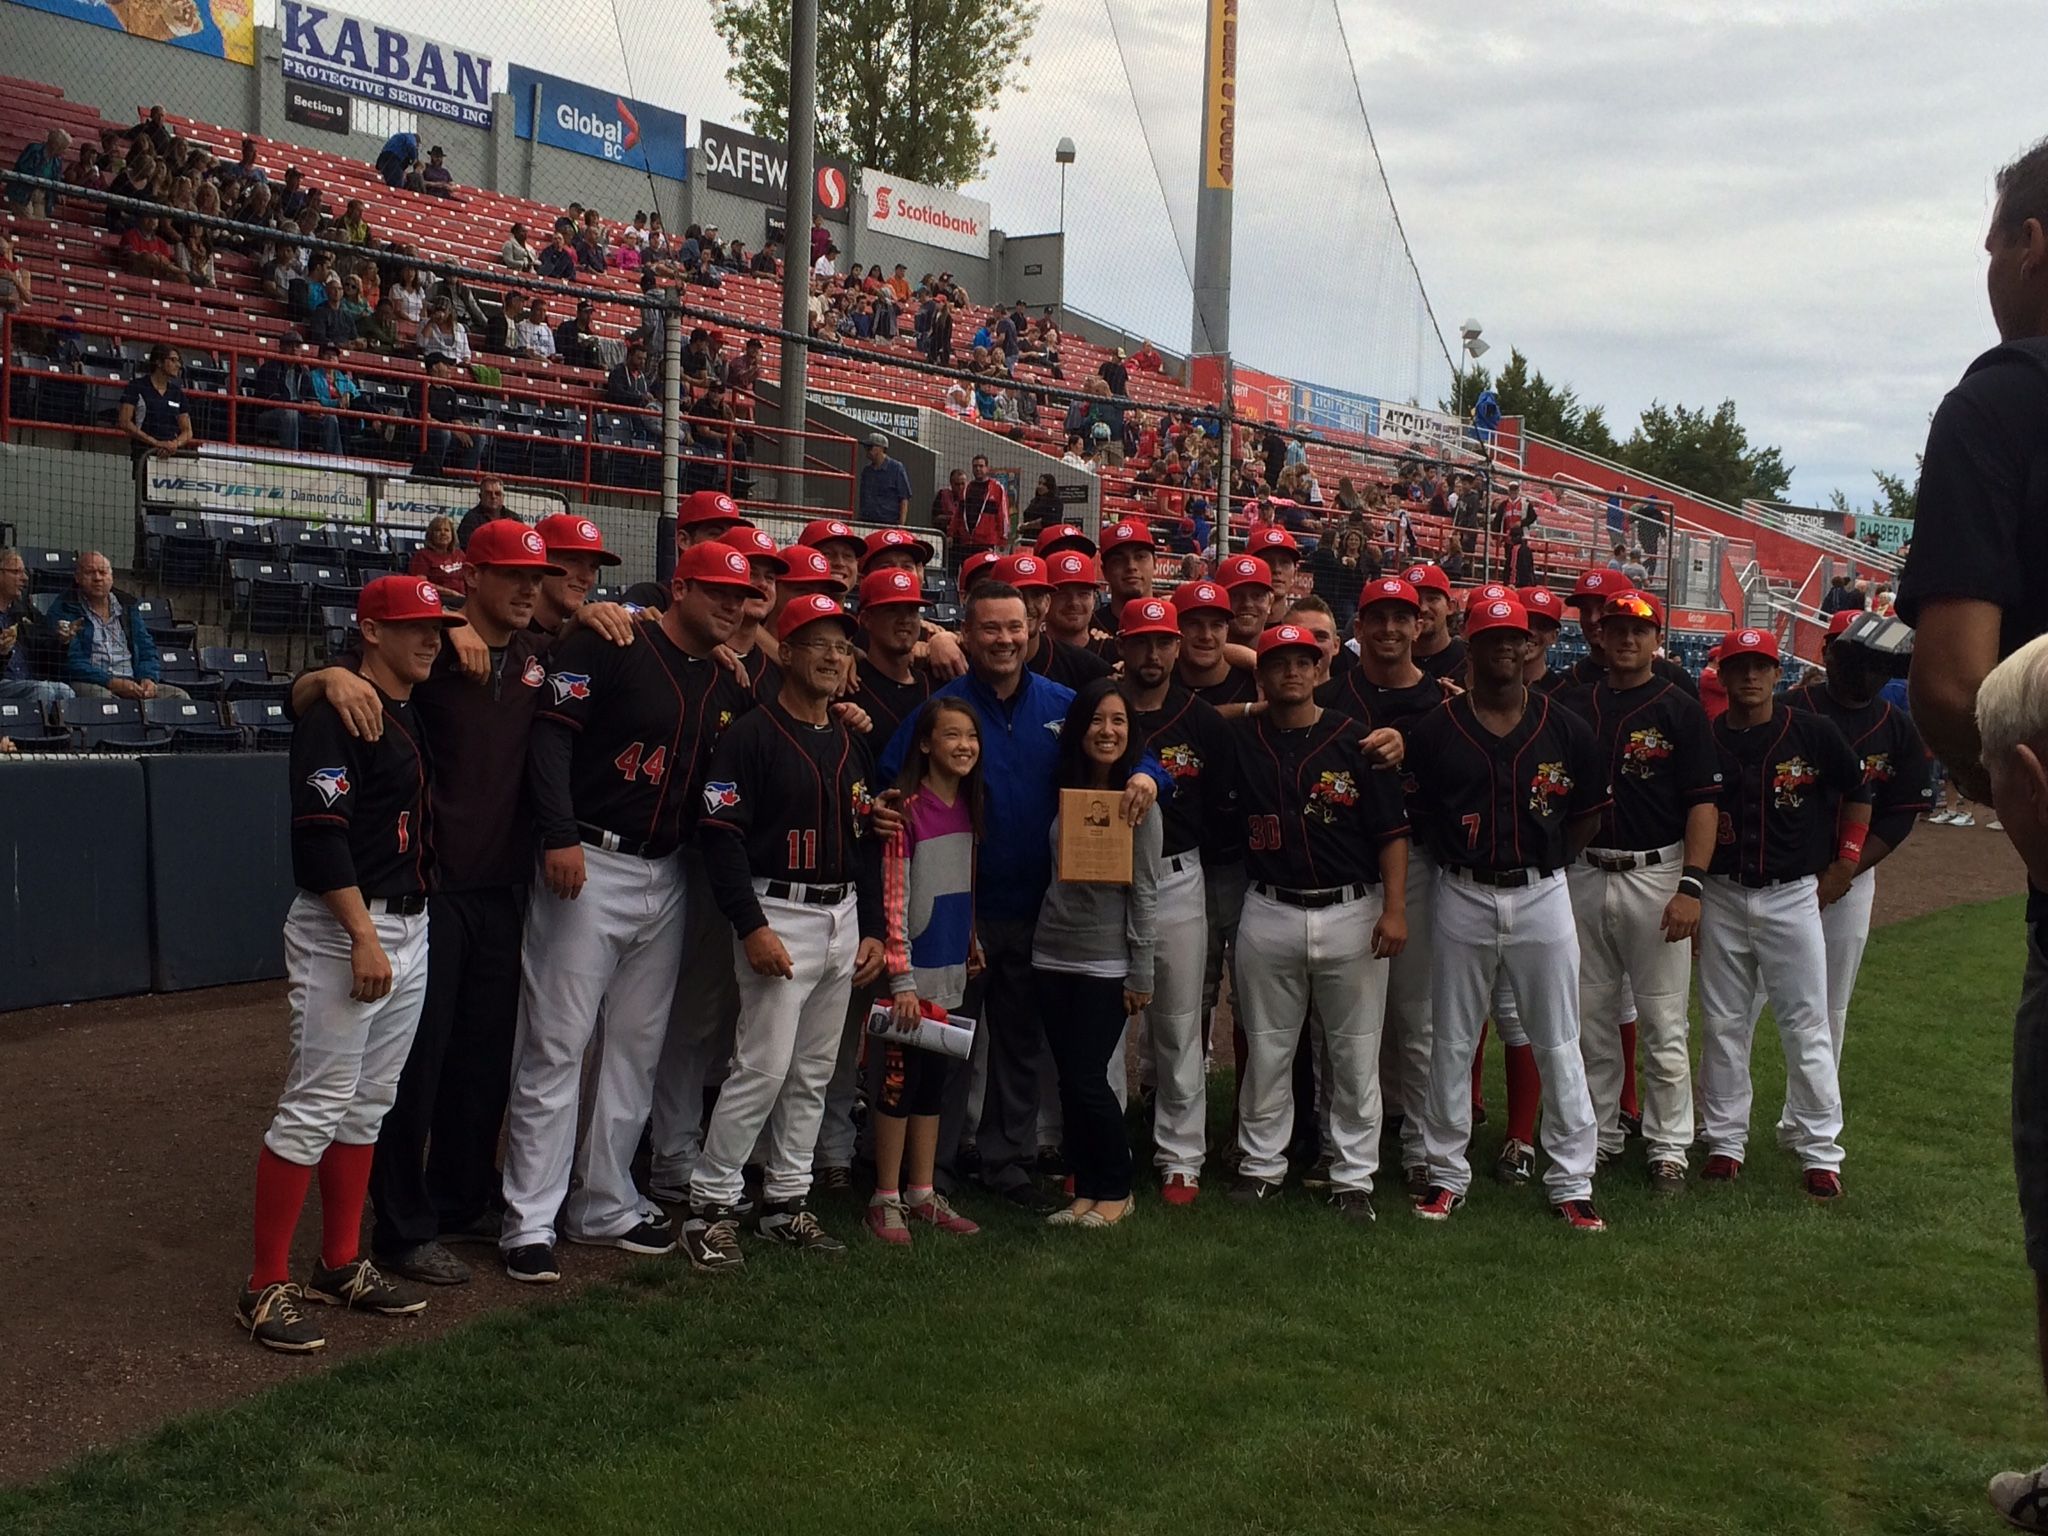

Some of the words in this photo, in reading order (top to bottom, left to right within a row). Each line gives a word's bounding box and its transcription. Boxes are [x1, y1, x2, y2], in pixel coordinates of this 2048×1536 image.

[281, 1, 492, 105] KABAN
[283, 57, 385, 97] PROTECTIVE
[388, 87, 459, 117] SERVICES
[463, 108, 491, 126] INC.
[293, 93, 336, 115] Section
[336, 105, 344, 117] 9
[556, 103, 622, 144] Global
[603, 142, 622, 161] BC
[704, 137, 788, 192] SAFEW
[897, 199, 978, 237] Scotiabank
[152, 478, 266, 497] WESTJET
[290, 489, 337, 502] Diamond
[337, 492, 363, 507] Club
[387, 501, 470, 517] WESTJE
[1859, 521, 1899, 543] BARBER
[1153, 560, 1182, 576] ordon
[615, 741, 666, 785] 44
[397, 810, 411, 853] 1
[786, 829, 817, 870] 11
[1248, 814, 1281, 850] 30
[1461, 812, 1481, 850] 7
